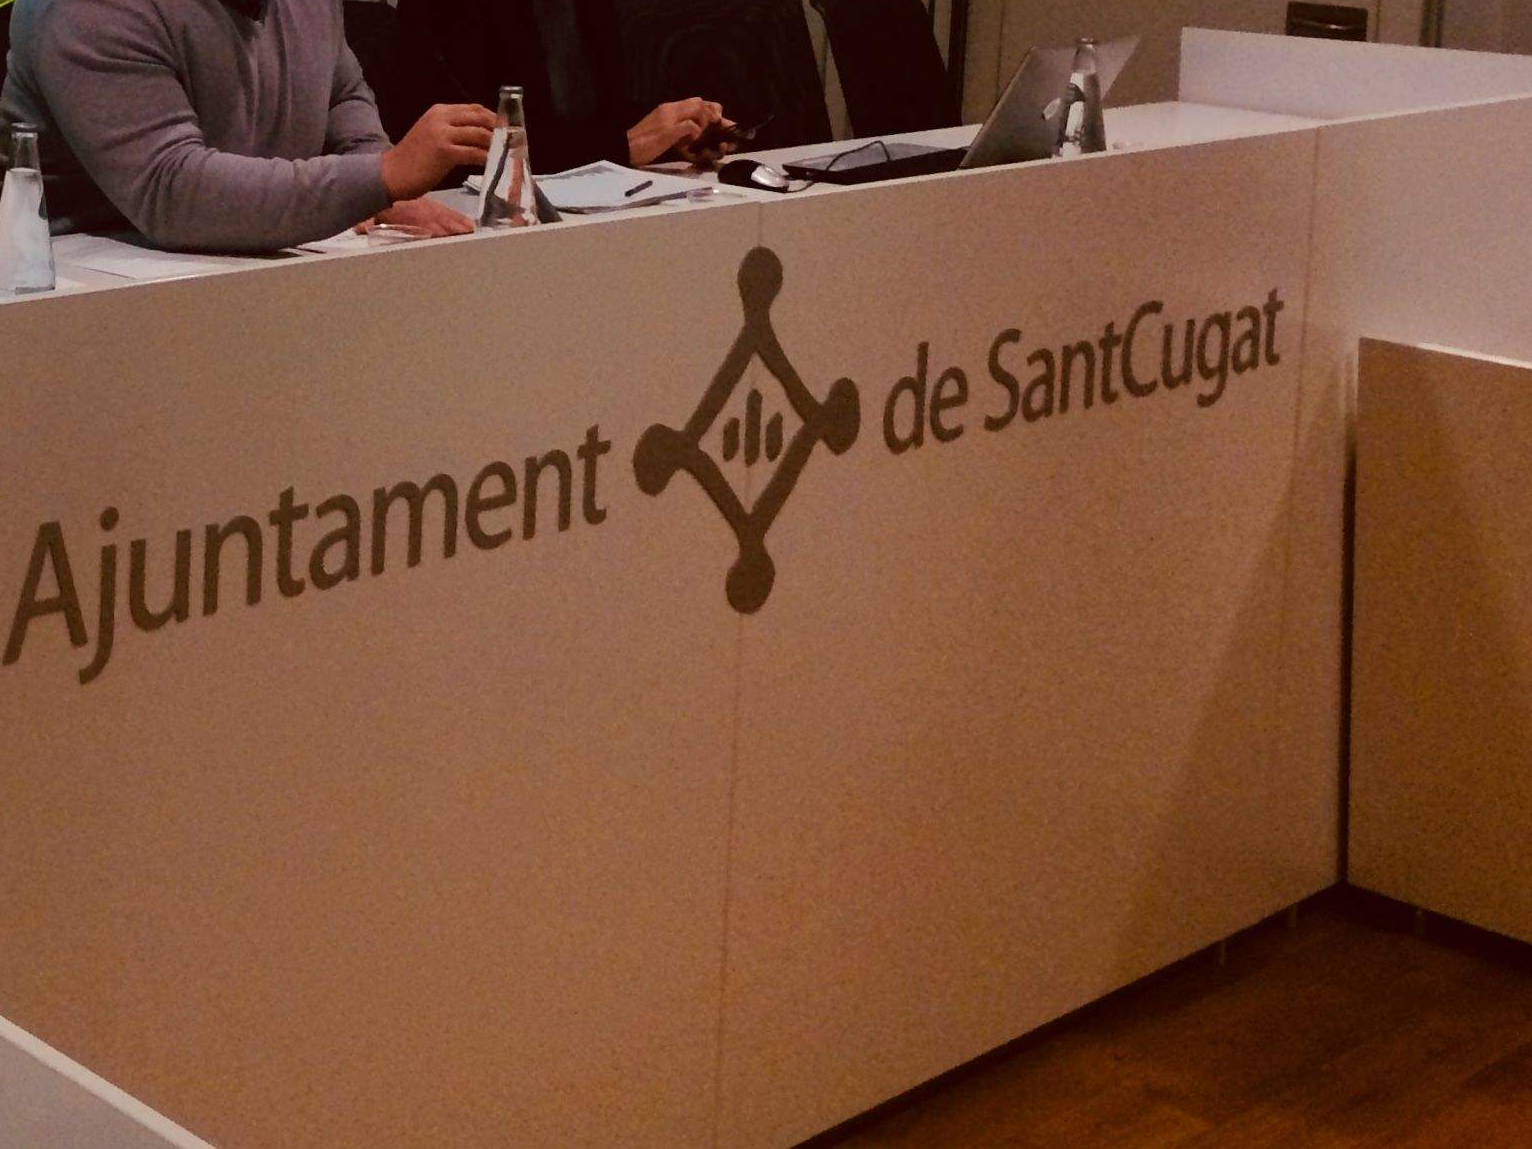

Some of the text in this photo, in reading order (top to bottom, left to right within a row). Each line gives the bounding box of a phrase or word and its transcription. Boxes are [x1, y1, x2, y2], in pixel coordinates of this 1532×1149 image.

[1, 289, 1285, 687] Ajuntament de SantCugat
